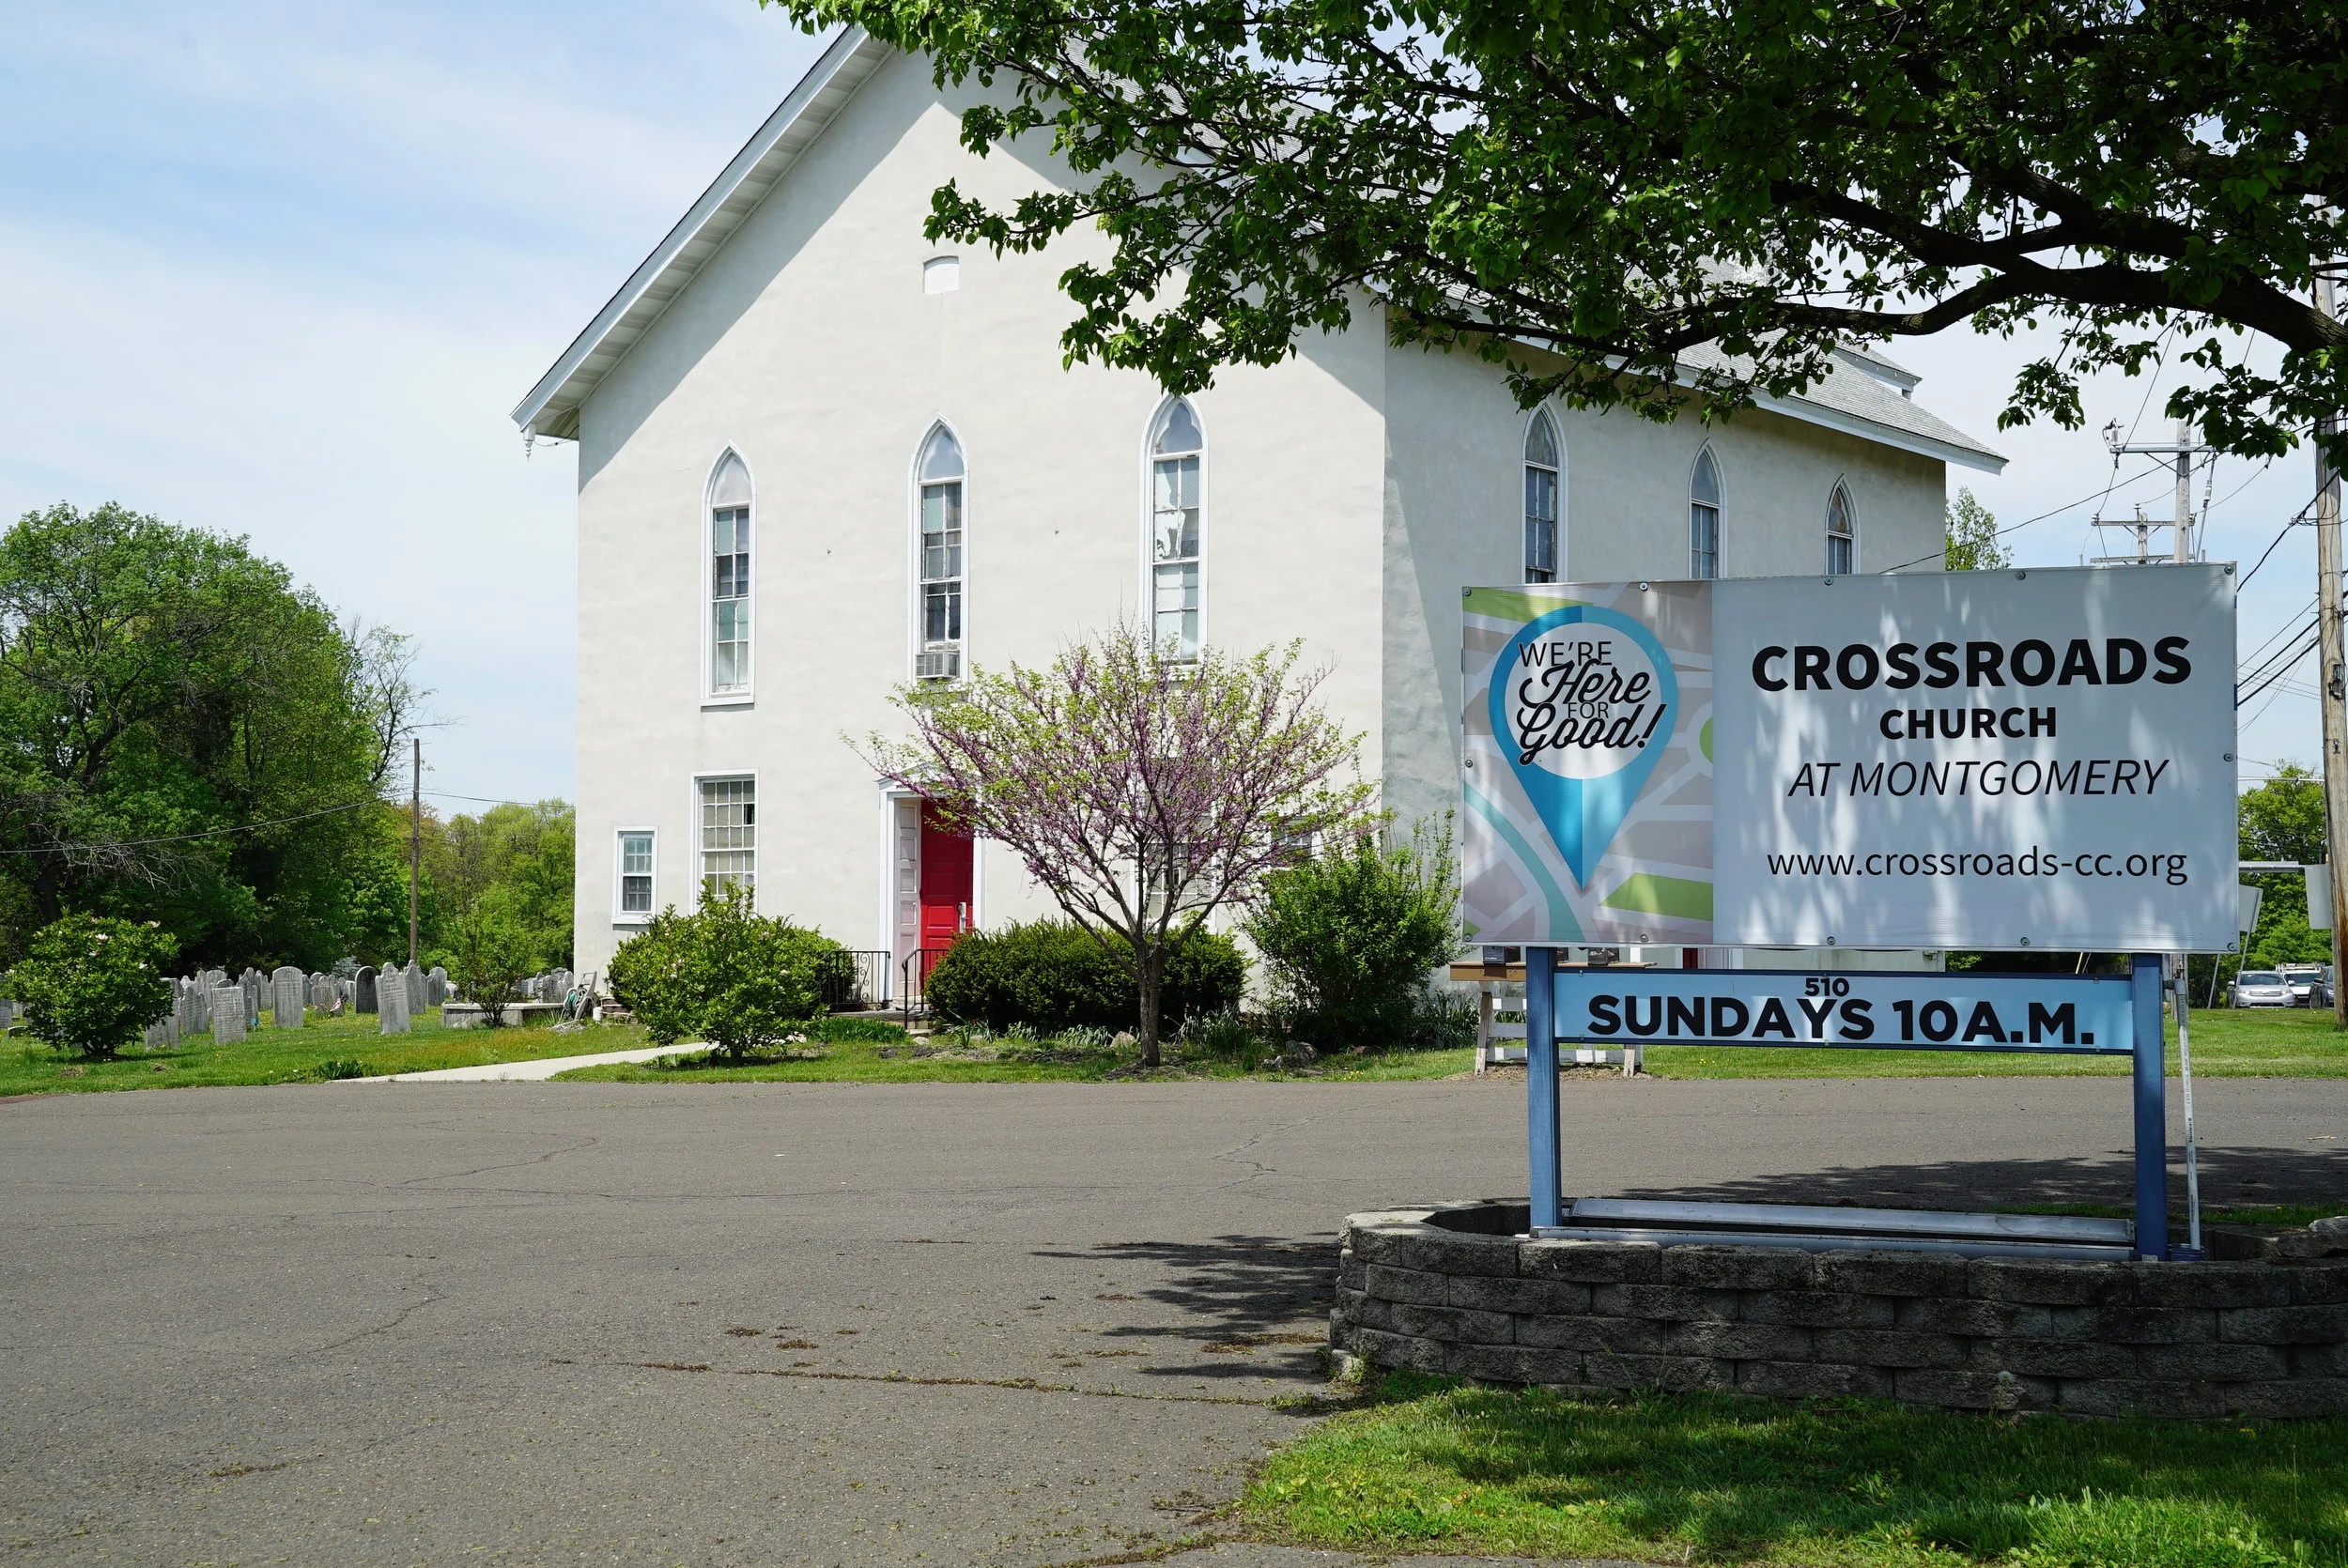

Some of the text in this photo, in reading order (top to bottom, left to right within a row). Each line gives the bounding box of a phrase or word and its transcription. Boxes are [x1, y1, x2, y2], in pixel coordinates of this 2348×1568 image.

[1519, 641, 1613, 668] WE'RE
[1752, 636, 2192, 692] CROSSROADS
[1519, 658, 1652, 710] Here
[1568, 701, 1609, 719] FOR
[1879, 706, 2057, 740] CHURCH
[1516, 703, 1667, 765] Good!
[1788, 759, 2170, 796] AT MONTGOMERY
[1767, 845, 2188, 885] www.crossroads-cc.org
[1804, 977, 1850, 997] 510
[1587, 994, 2094, 1045] SUNDAYS 10A.M.
